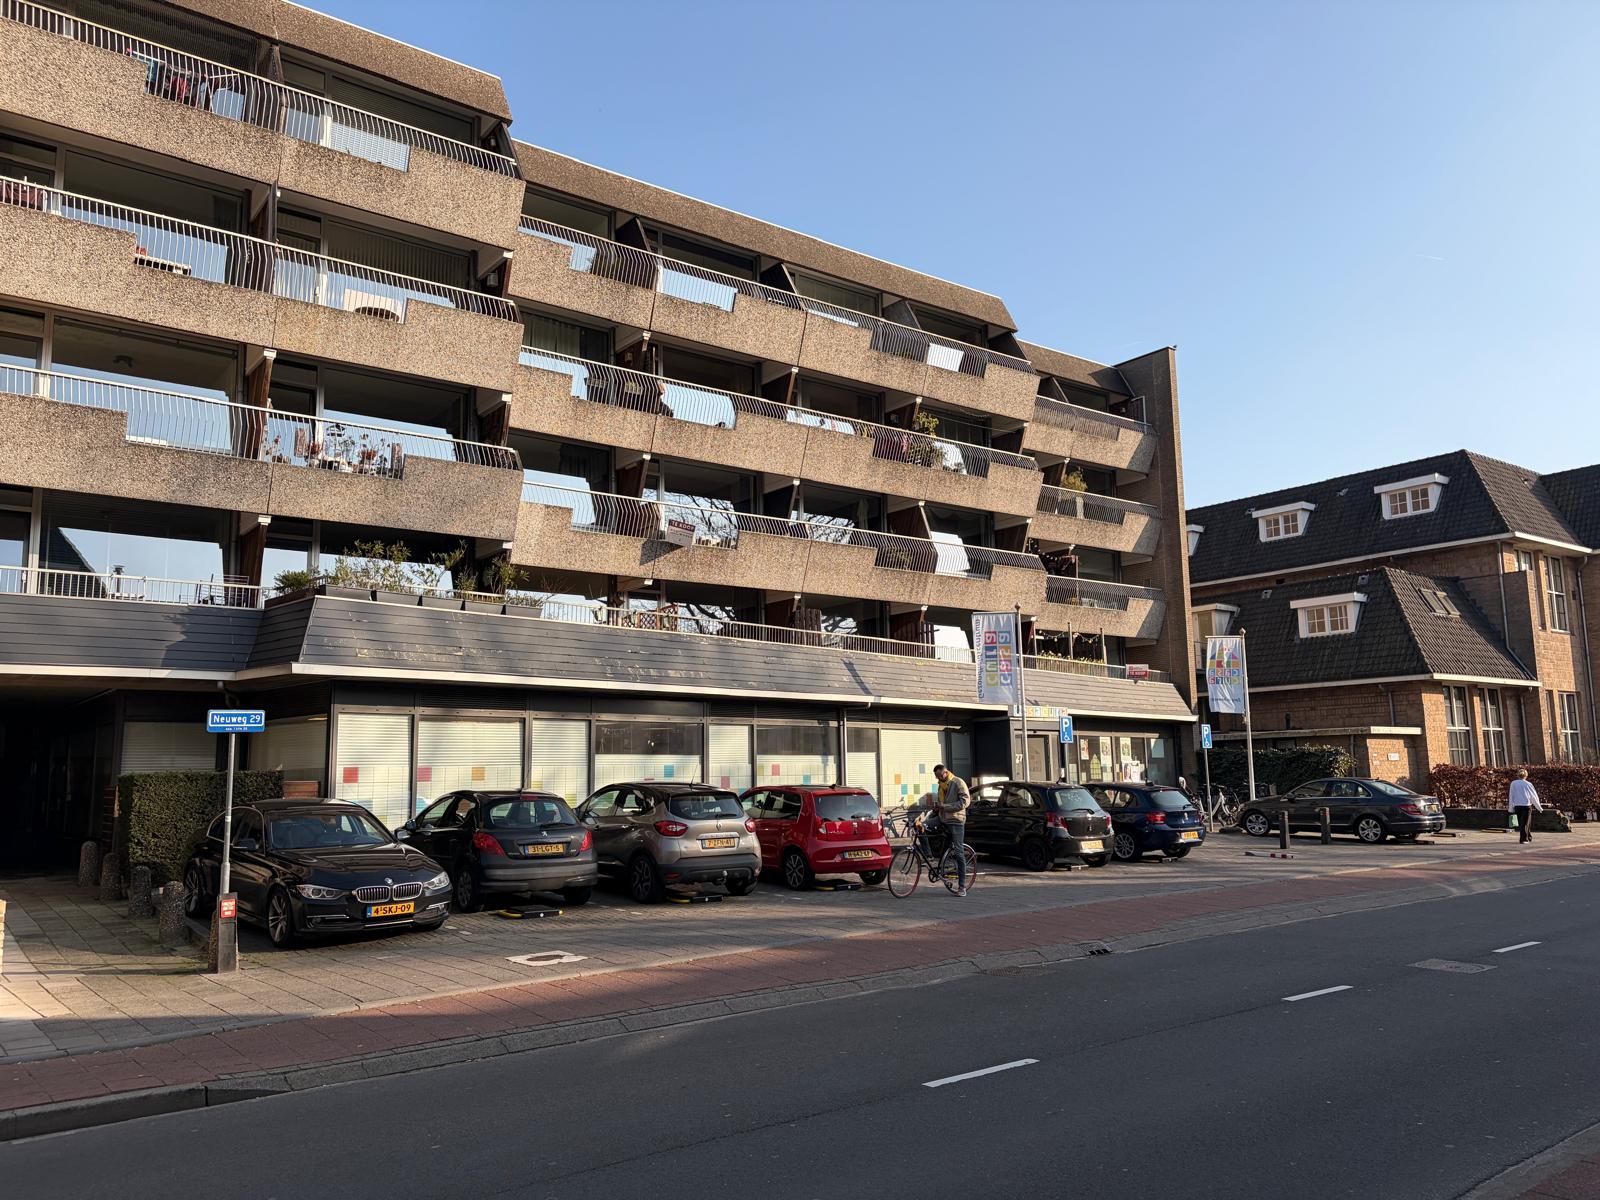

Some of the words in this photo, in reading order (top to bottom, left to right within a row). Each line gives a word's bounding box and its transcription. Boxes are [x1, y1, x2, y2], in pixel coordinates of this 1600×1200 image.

[213, 715, 247, 725] Neuweg
[250, 715, 261, 723] 29
[1062, 718, 1070, 732] P
[1203, 726, 1209, 738] P
